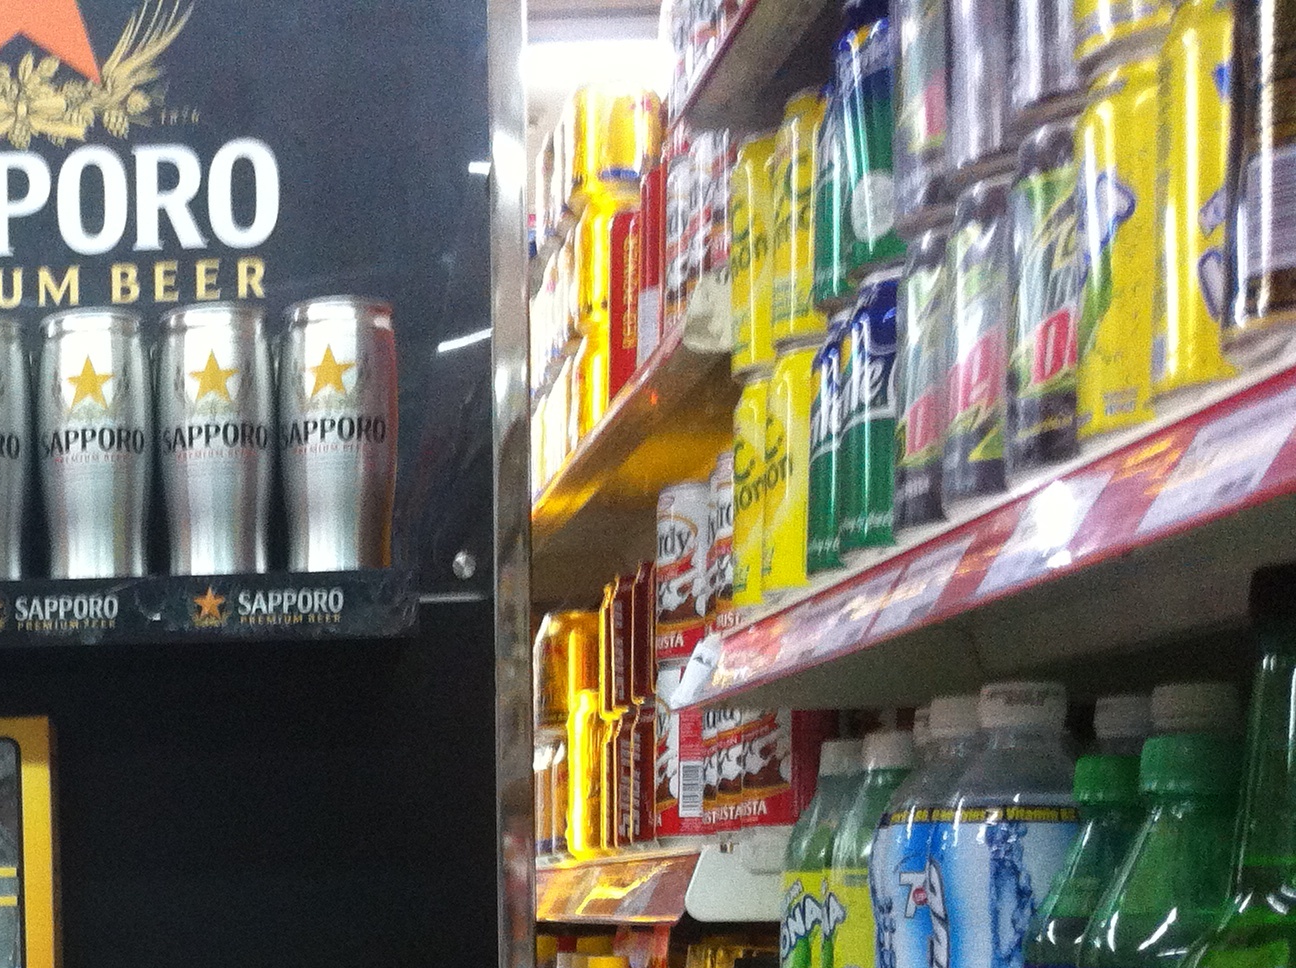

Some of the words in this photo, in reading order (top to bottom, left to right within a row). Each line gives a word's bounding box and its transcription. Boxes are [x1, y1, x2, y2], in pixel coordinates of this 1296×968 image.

[110, 256, 268, 305] BEER
[45, 426, 145, 456] SAPPORO
[163, 423, 268, 452] SAPPORO
[281, 416, 388, 450] SAPPORO
[657, 527, 691, 563] rdy
[15, 595, 118, 621] SAPPORO
[238, 588, 344, 615] SAPPORO
[17, 619, 80, 631] PREMIUM
[83, 618, 116, 629] BEER
[240, 613, 303, 625] PREMIUM
[308, 612, 342, 624] BEER
